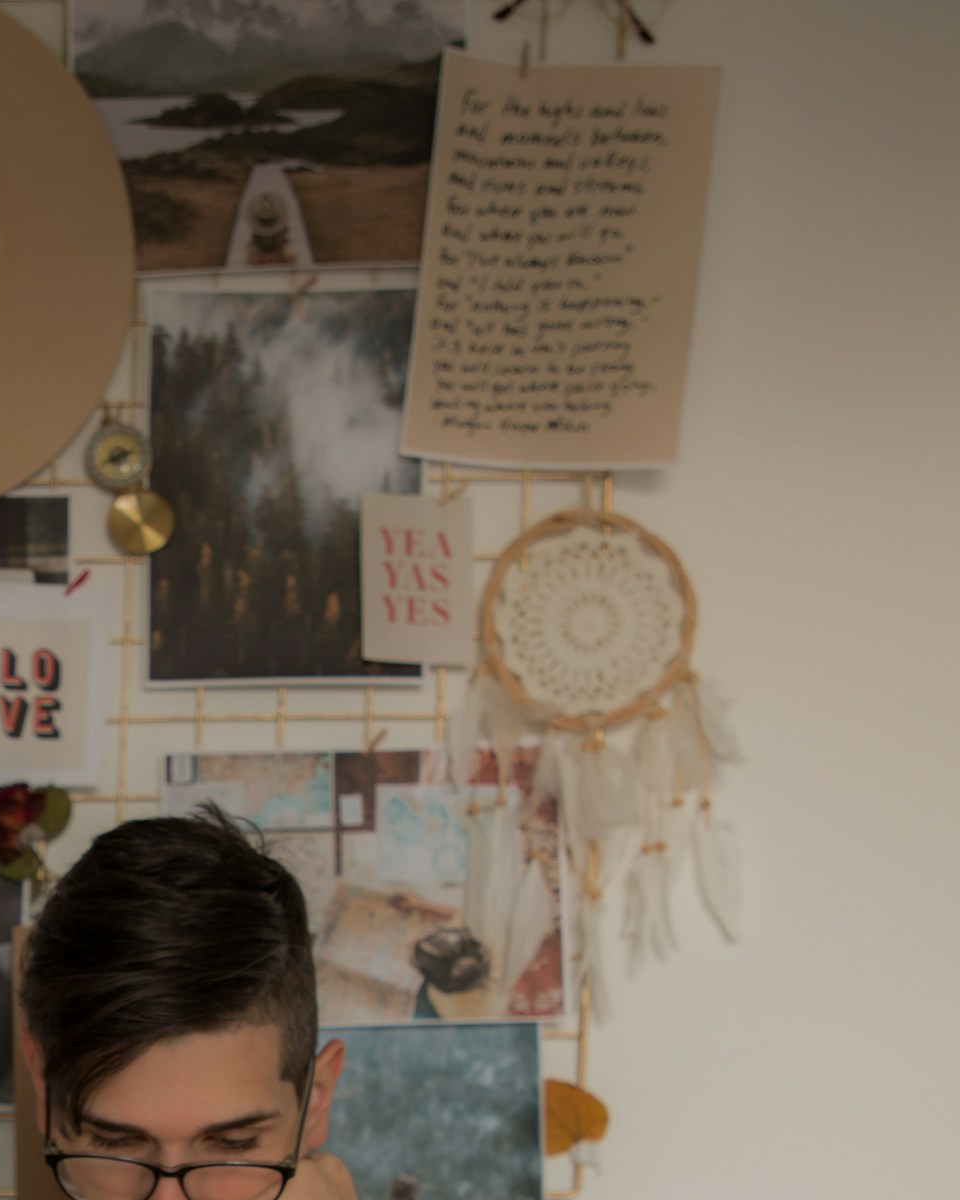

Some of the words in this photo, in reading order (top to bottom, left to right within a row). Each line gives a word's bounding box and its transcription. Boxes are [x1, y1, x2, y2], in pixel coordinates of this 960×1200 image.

[377, 525, 453, 560] YEA
[381, 560, 451, 591] YAS
[381, 594, 452, 628] YES
[0, 646, 61, 691] LO
